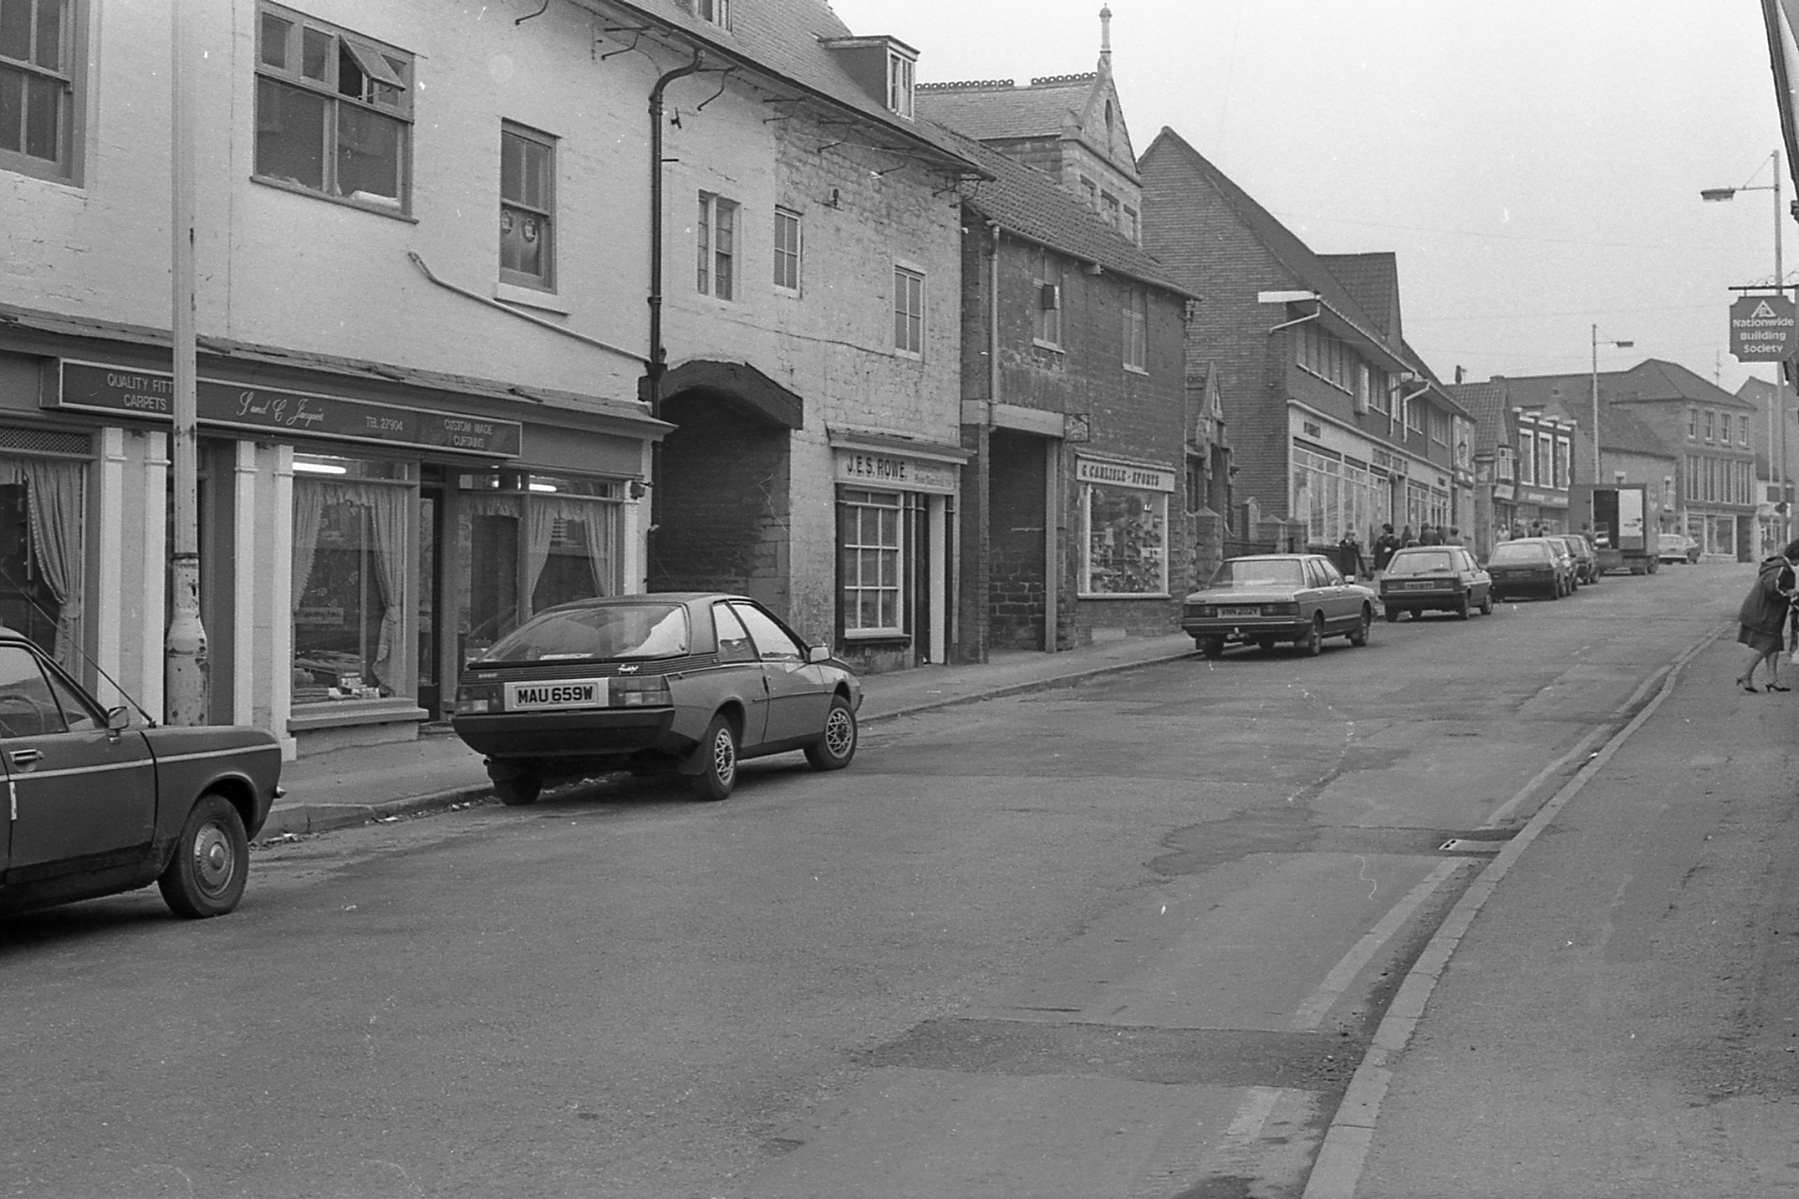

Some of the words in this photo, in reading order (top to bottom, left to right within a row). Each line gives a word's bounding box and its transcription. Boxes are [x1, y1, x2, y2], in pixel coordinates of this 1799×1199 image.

[1732, 317, 1795, 328] Nationwide
[1740, 330, 1786, 341] Building
[1743, 344, 1784, 353] Society
[107, 373, 148, 391] QUALITY
[152, 378, 174, 393] FITT
[123, 393, 168, 410] CARPETS
[1132, 471, 1160, 487] SPORTS
[518, 688, 549, 703] MAU
[551, 686, 593, 702] 659W
